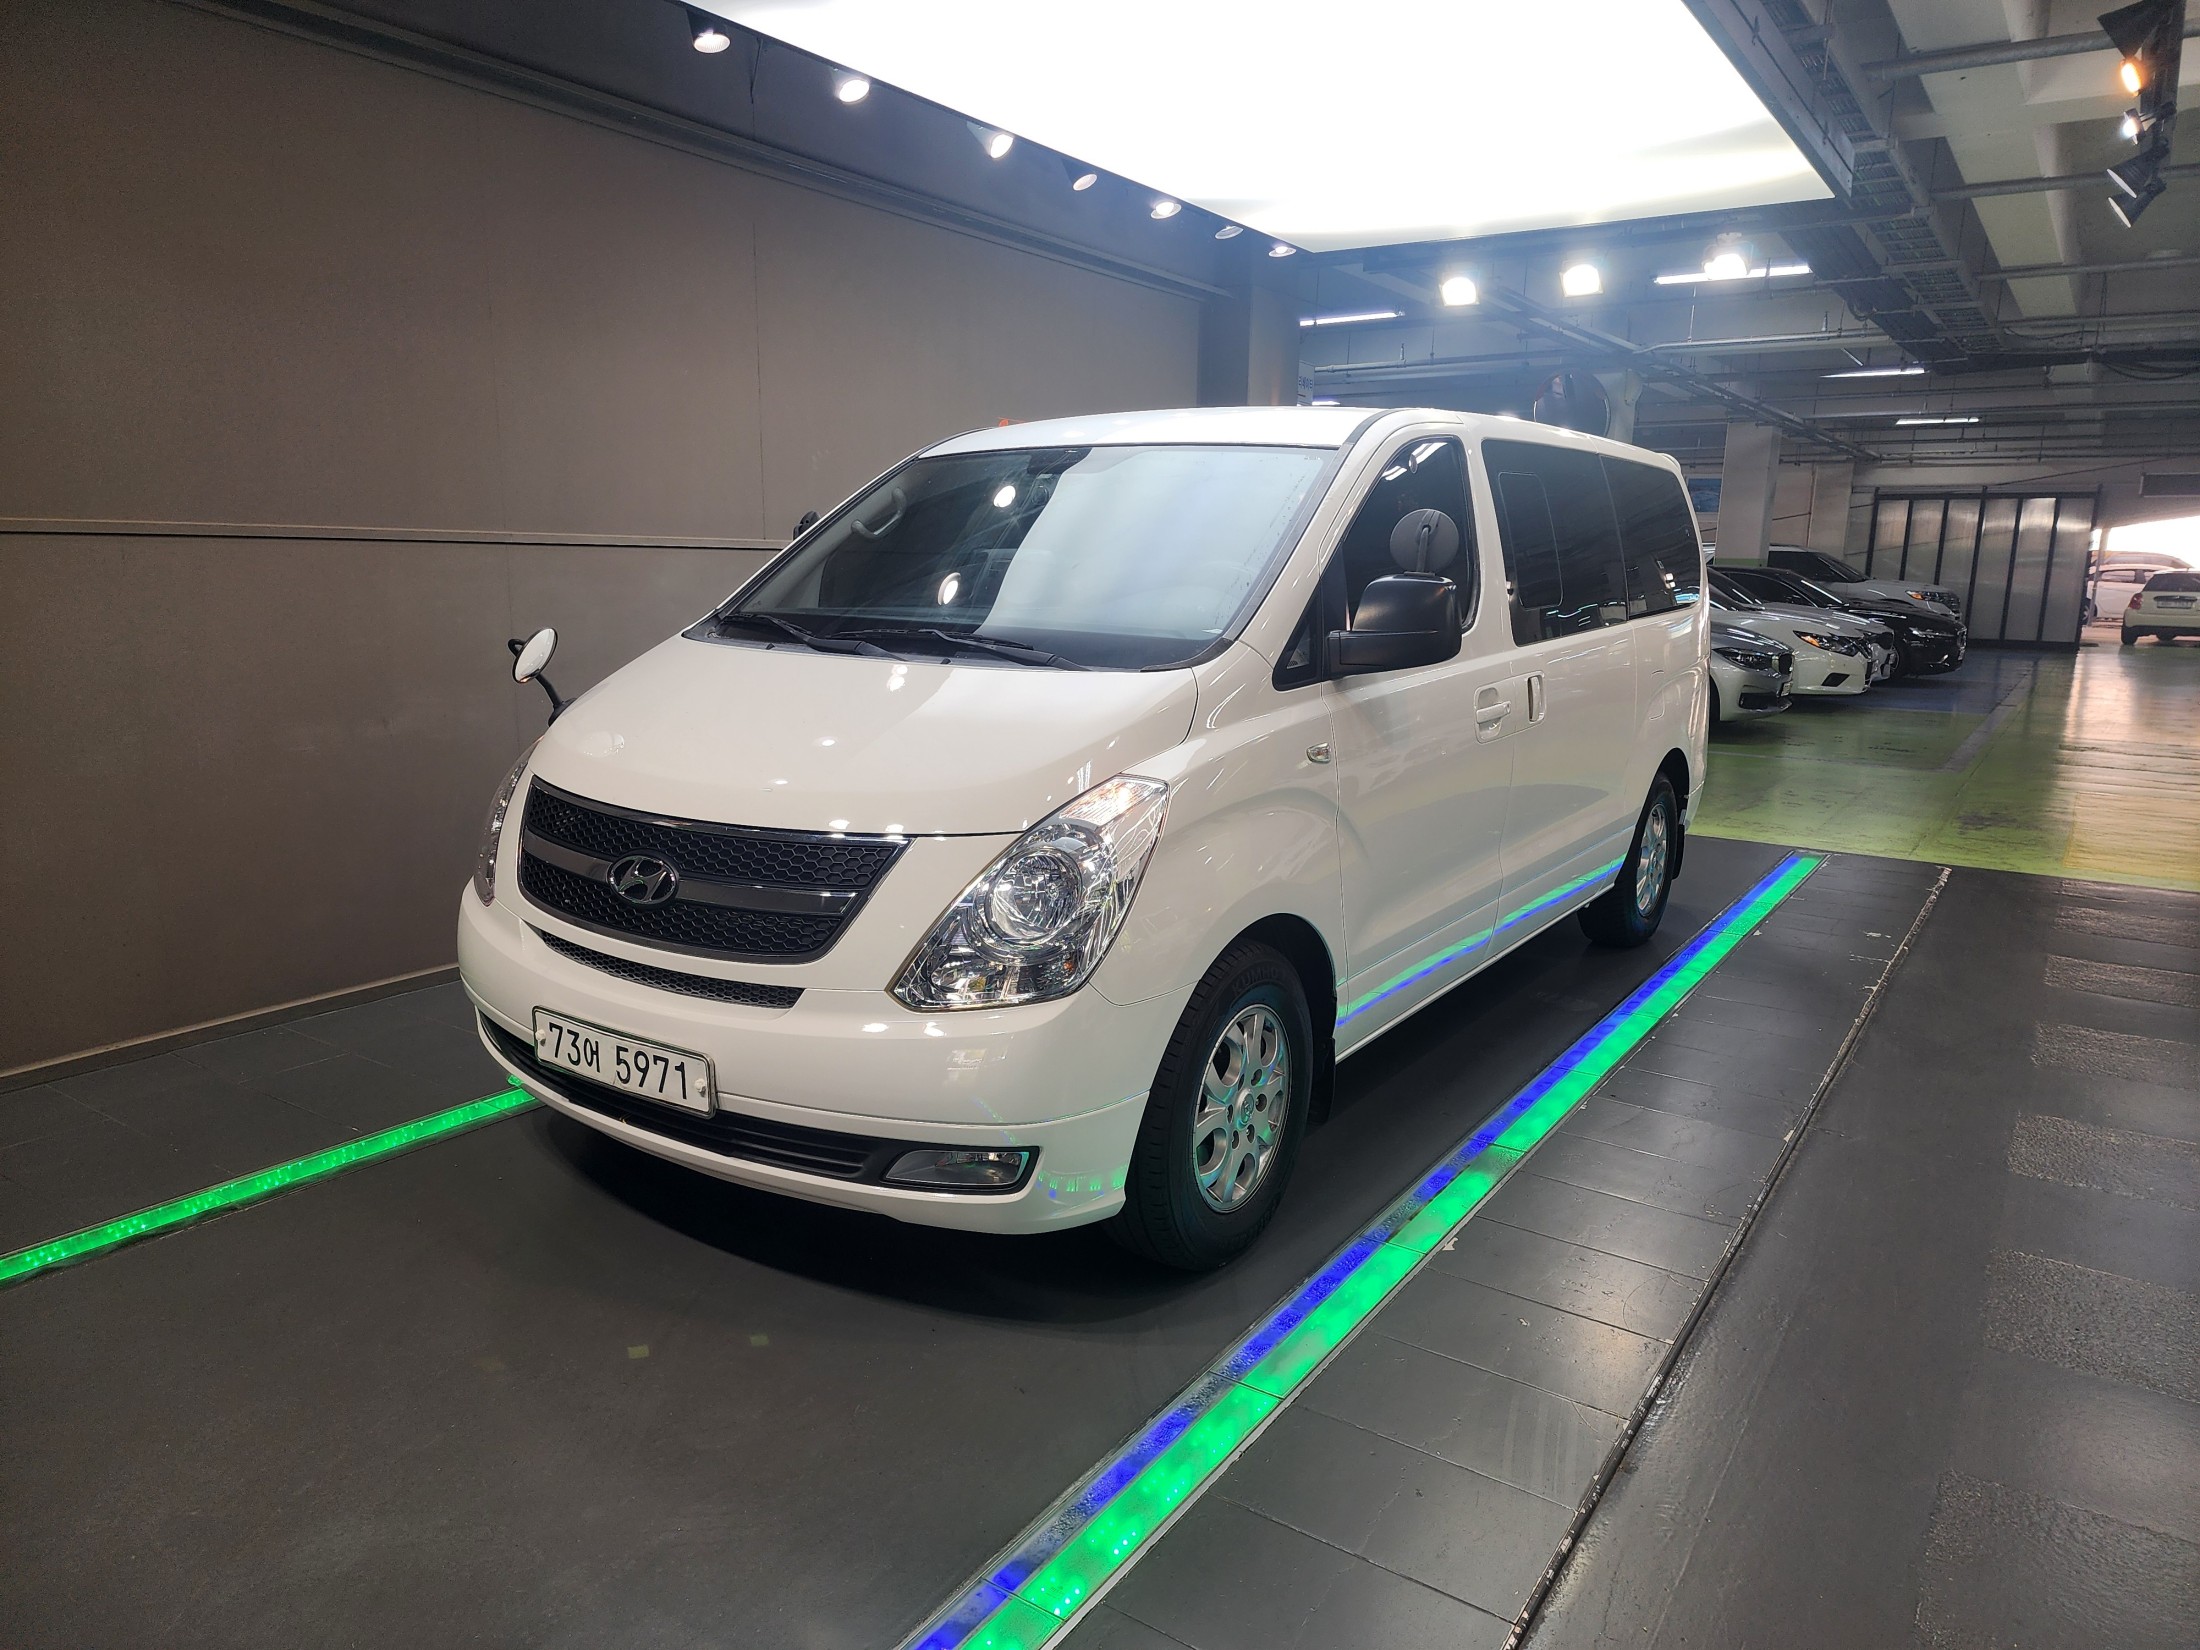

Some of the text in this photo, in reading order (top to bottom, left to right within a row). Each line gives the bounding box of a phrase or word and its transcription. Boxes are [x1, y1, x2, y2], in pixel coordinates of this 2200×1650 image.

[1232, 964, 1279, 990] KUMHO
[549, 1021, 687, 1100] 73어 5971
